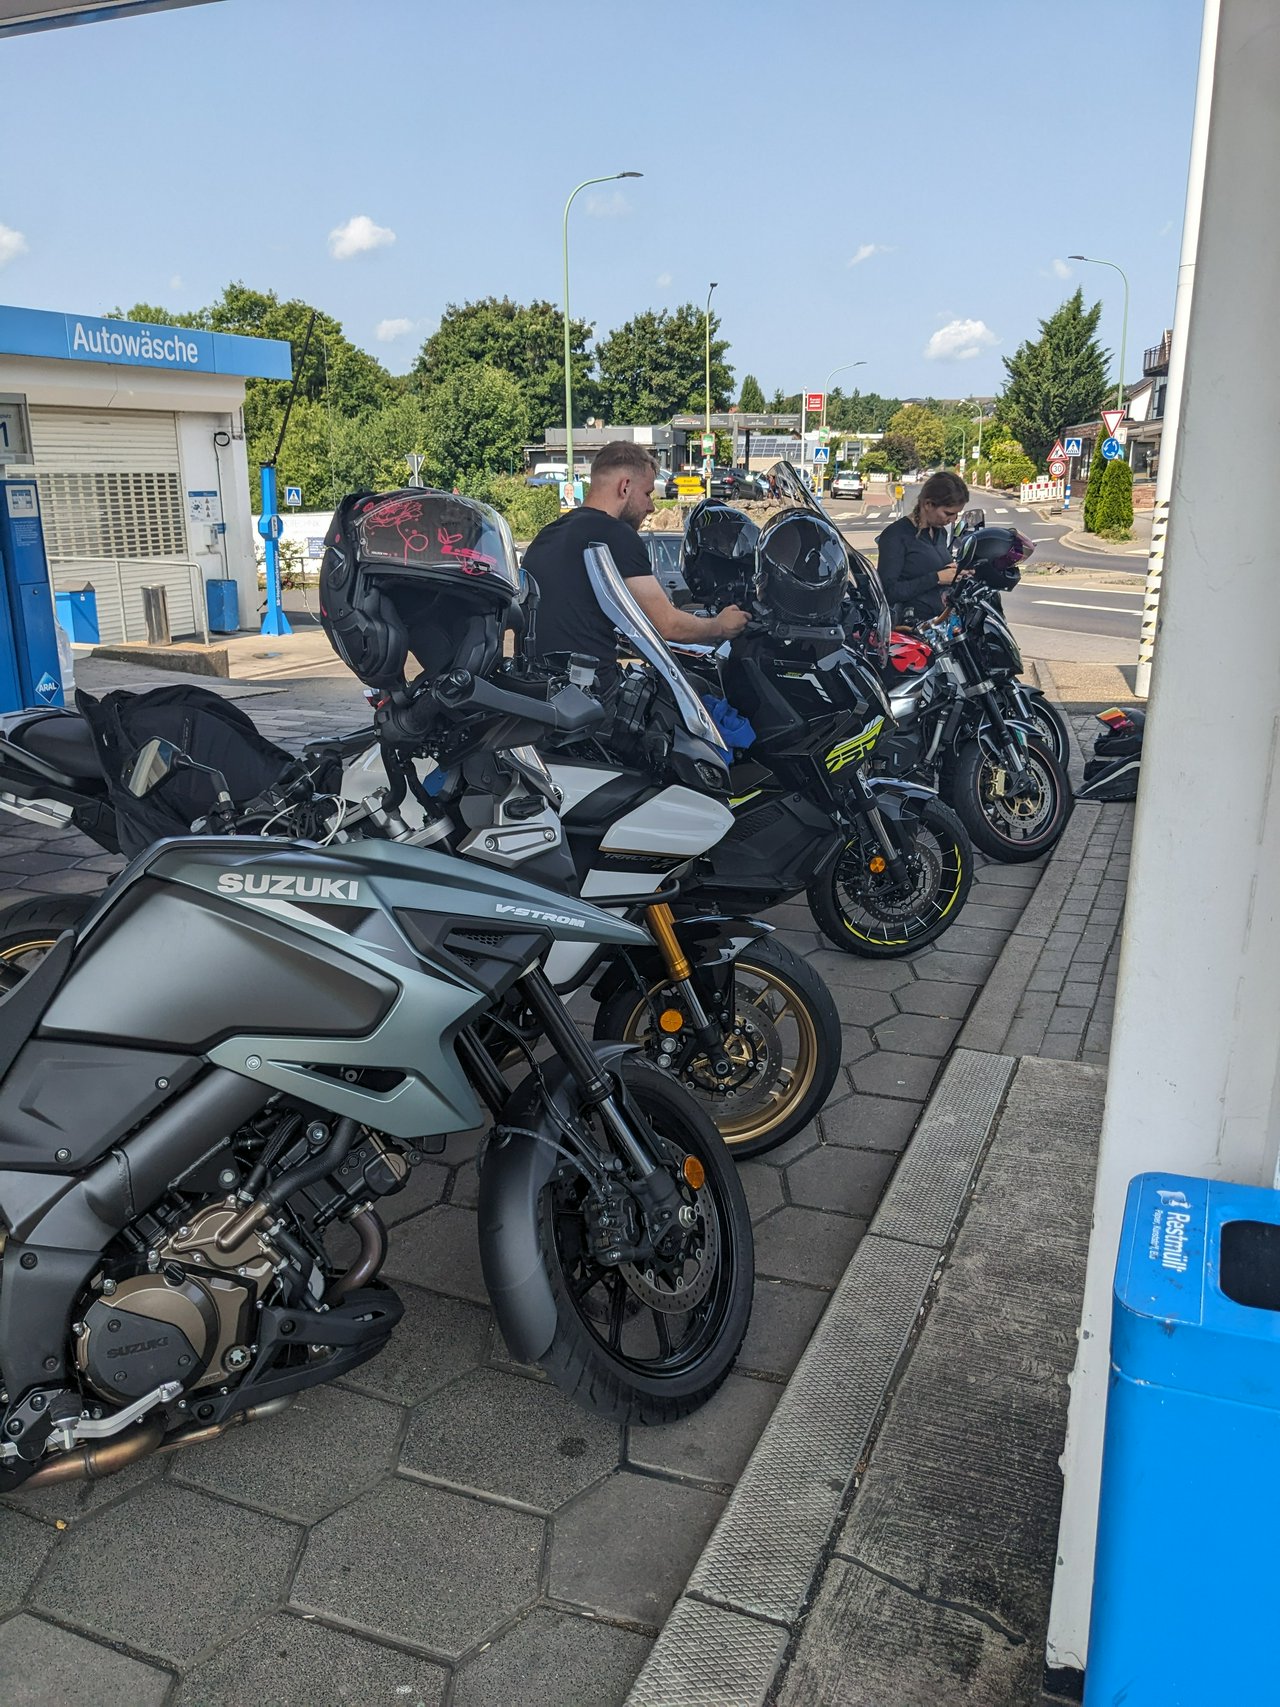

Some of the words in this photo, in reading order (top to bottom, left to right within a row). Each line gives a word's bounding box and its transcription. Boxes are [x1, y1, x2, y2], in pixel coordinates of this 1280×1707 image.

[73, 321, 199, 364] Autowäsche
[1053, 465, 1062, 473] 30
[39, 682, 57, 692] ARAL
[604, 853, 660, 862] TRACER
[217, 872, 359, 900] SUZUKI
[495, 903, 585, 928] V-STROM
[106, 1336, 168, 1359] SUZUKI
